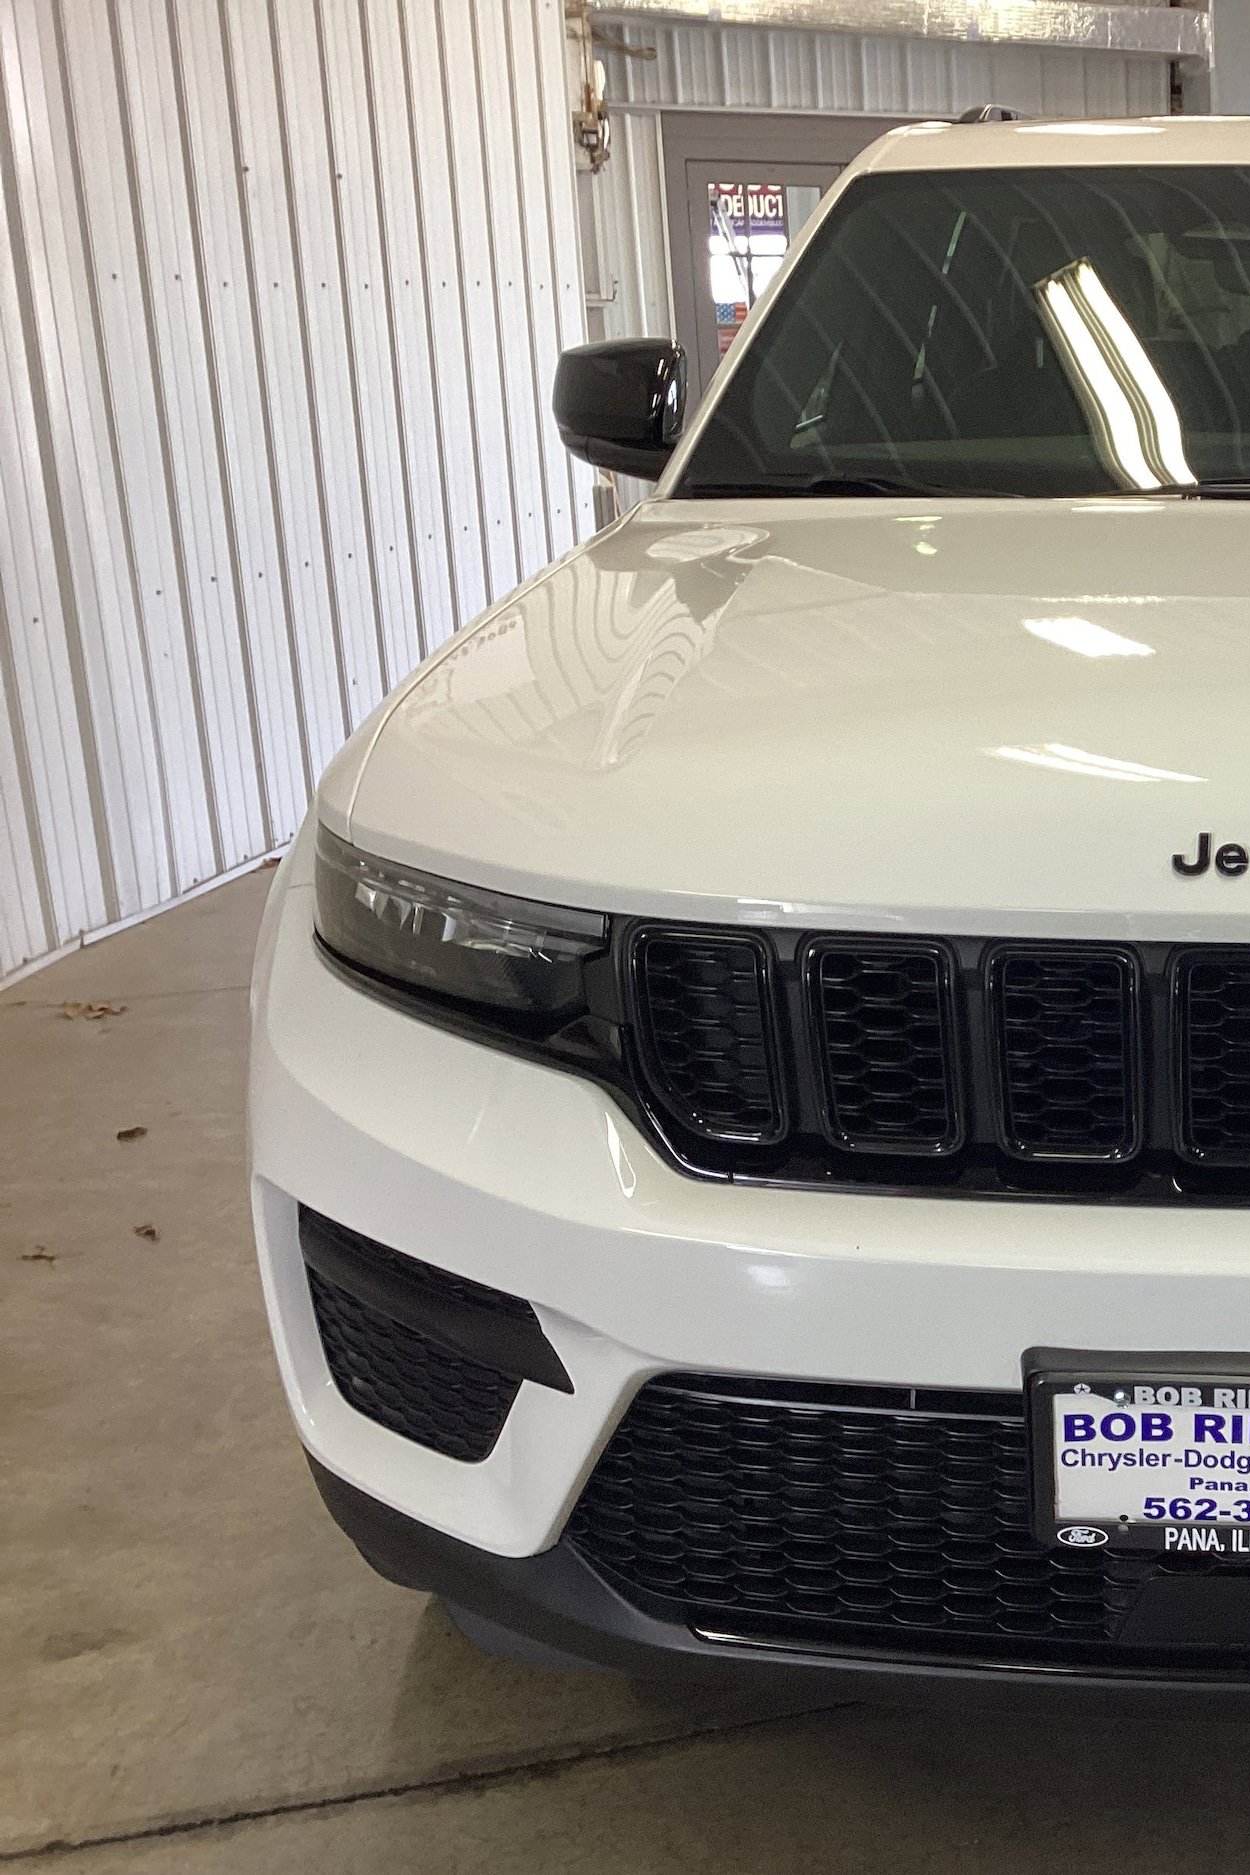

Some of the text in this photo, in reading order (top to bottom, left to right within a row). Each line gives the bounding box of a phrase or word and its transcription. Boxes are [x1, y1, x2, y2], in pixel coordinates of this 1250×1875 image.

[1133, 1386, 1202, 1406] BOB
[1063, 1413, 1174, 1442] BOB
[1164, 1527, 1226, 1552] PANA,
